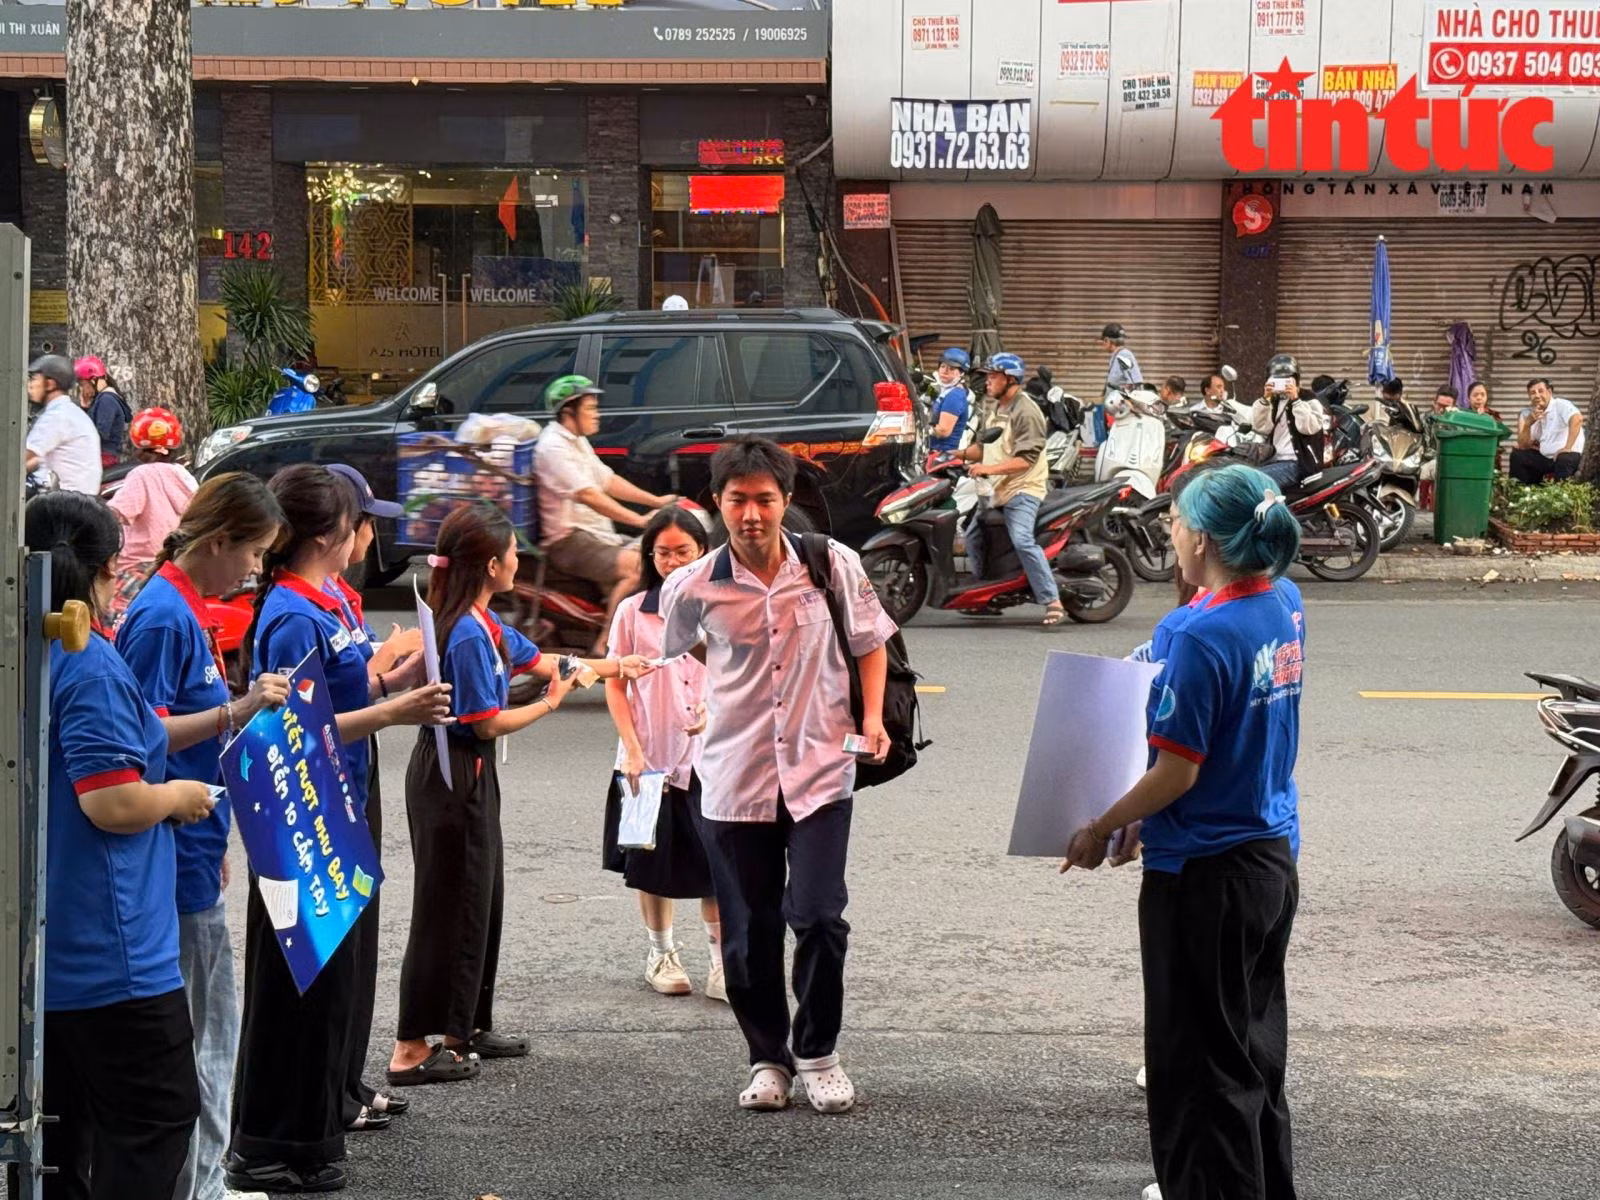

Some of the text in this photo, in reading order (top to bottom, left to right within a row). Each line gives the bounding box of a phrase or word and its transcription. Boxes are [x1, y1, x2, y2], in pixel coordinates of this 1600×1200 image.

[1257, 11, 1304, 27] 0911 7777 69
[1436, 2, 1483, 38] NHÀ
[1492, 9, 1540, 38] CHO
[665, 28, 808, 42] 0789 252525 / 19006925
[913, 28, 930, 42] 0971
[931, 28, 945, 41] 132
[1060, 50, 1078, 70] 0932
[1080, 50, 1093, 70] 973
[1467, 51, 1518, 77] 0937
[1524, 51, 1562, 77] 504
[1122, 79, 1137, 90] CHO
[1324, 64, 1396, 91] BÁN NHÀ
[1123, 91, 1136, 102] 092
[1137, 90, 1150, 101] 432
[890, 131, 1030, 169] 0931.72.63.63
[224, 231, 273, 260] 142
[373, 287, 440, 302] WELCOME
[470, 288, 537, 303] WELCOME
[399, 346, 441, 358] HOTEL
[285, 801, 297, 826] 10
[310, 874, 331, 915] TAY
[328, 856, 351, 899] BAY
